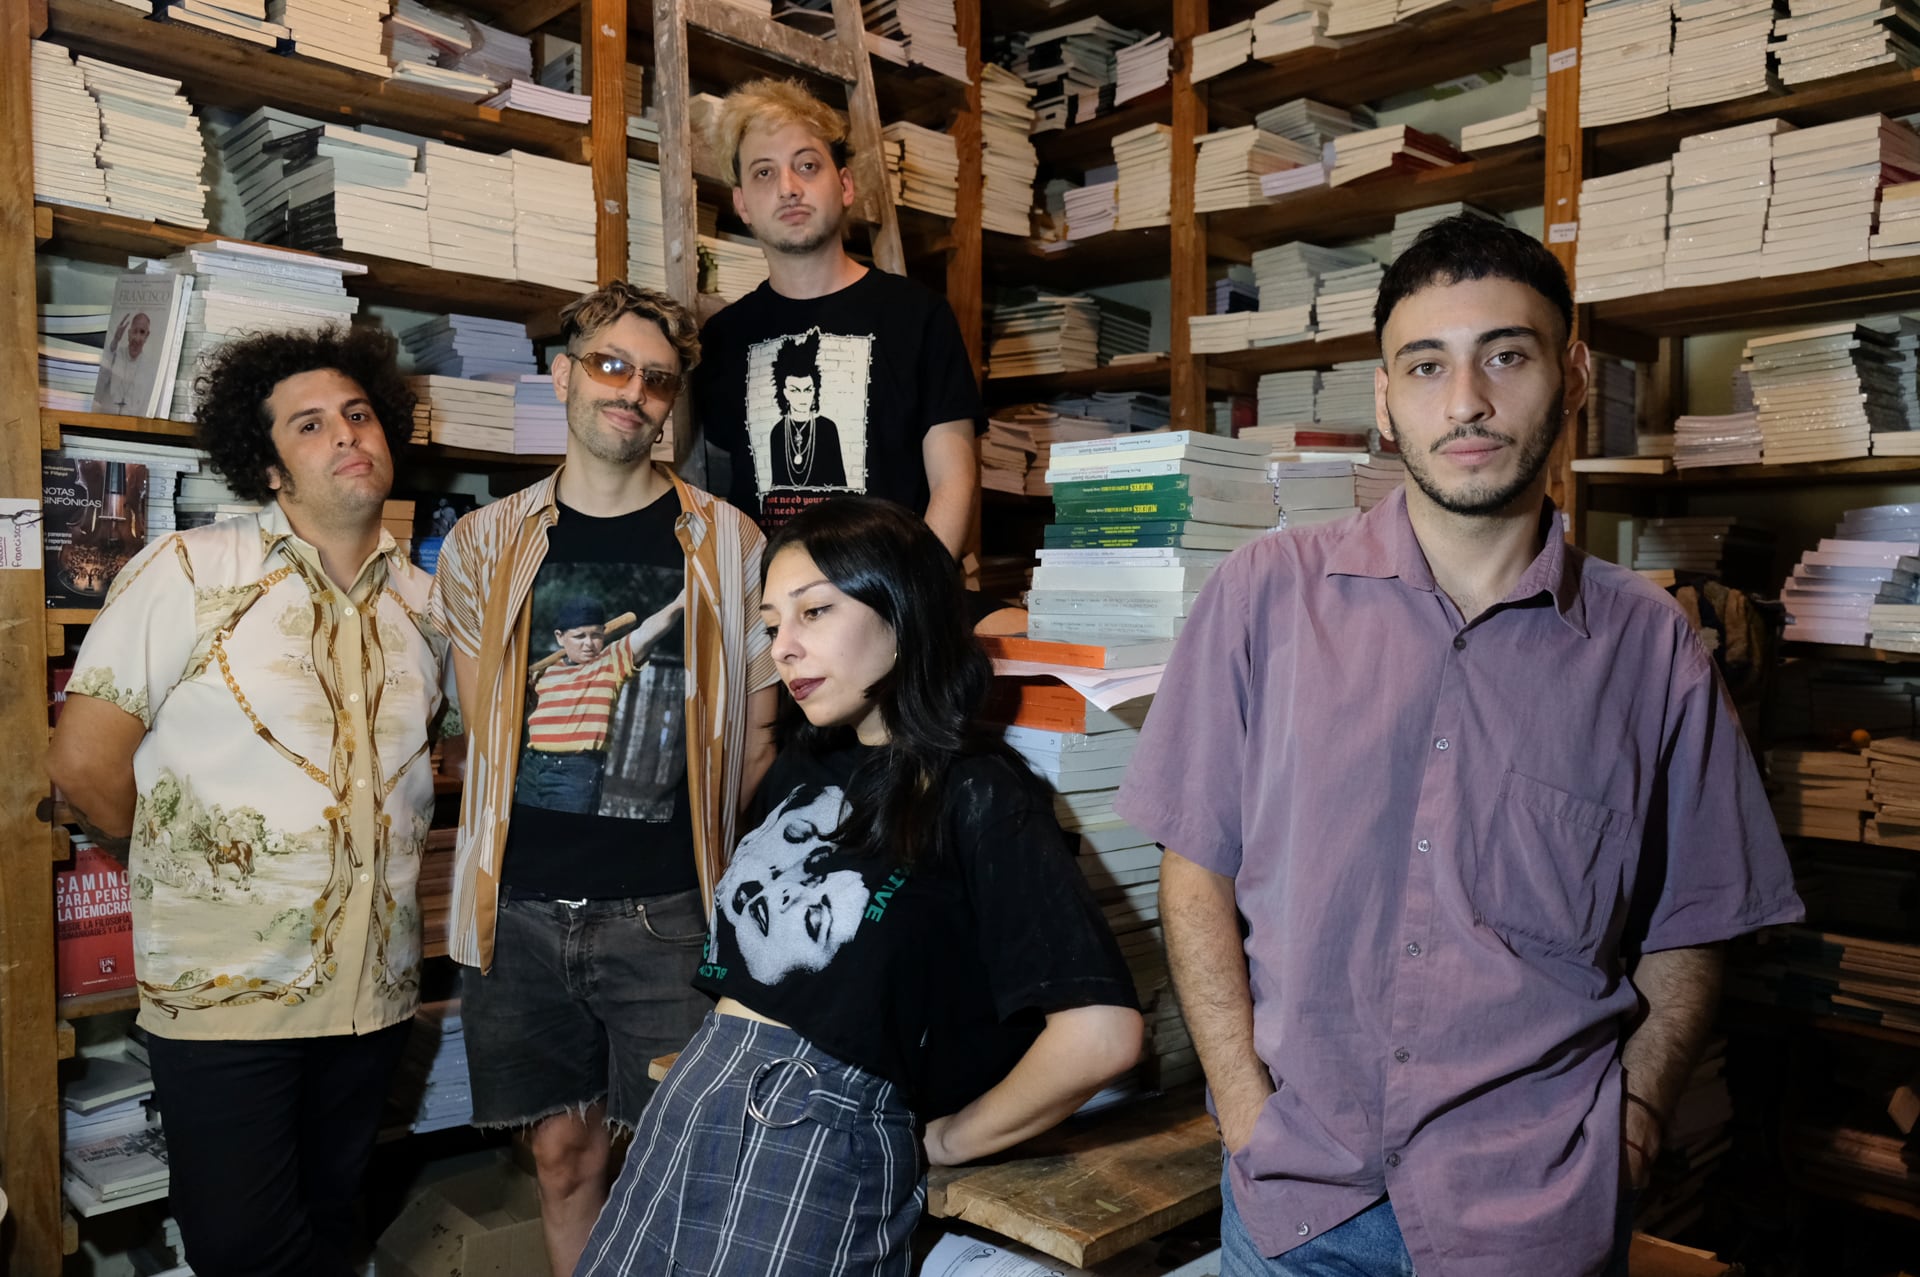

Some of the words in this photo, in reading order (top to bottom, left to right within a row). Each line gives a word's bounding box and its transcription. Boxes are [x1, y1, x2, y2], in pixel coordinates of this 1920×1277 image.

[780, 495, 801, 504] need
[57, 892, 91, 908] PARA
[95, 887, 131, 903] PENS
[57, 908, 73, 922] LA
